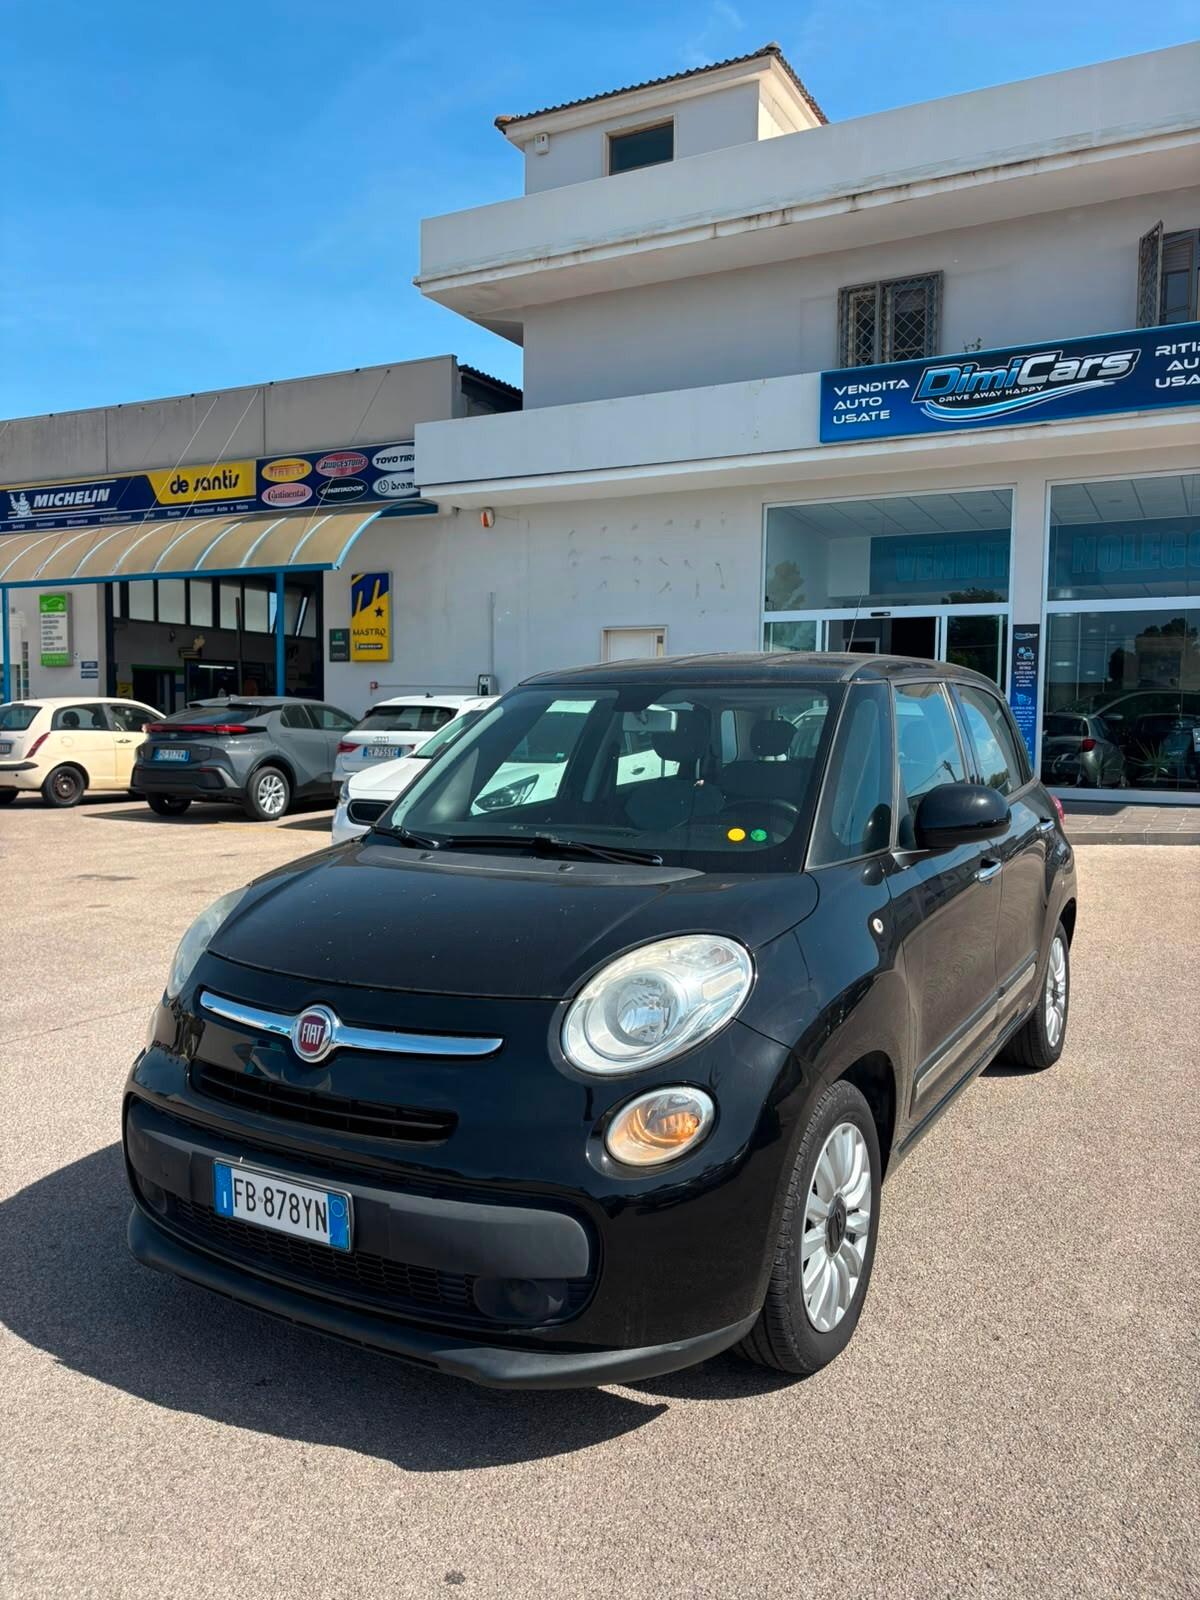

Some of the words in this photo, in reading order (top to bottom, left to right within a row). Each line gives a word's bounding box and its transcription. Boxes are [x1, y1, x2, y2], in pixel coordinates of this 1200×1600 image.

[1155, 341, 1200, 357] RITI
[917, 352, 1134, 398] DimiCars
[833, 379, 910, 396] VENDITA
[938, 393, 970, 403] DRIVE
[973, 389, 1003, 400] AWAY
[1005, 385, 1044, 396] HAPPY
[833, 397, 883, 411] AUTO
[833, 409, 891, 424] USATE
[375, 455, 399, 465] TOYO
[170, 474, 189, 495] de
[193, 469, 240, 492] santis
[391, 480, 416, 490] brem
[33, 488, 110, 508] MICHELIN
[353, 628, 386, 637] MASTRO
[301, 1023, 324, 1045] FIAT
